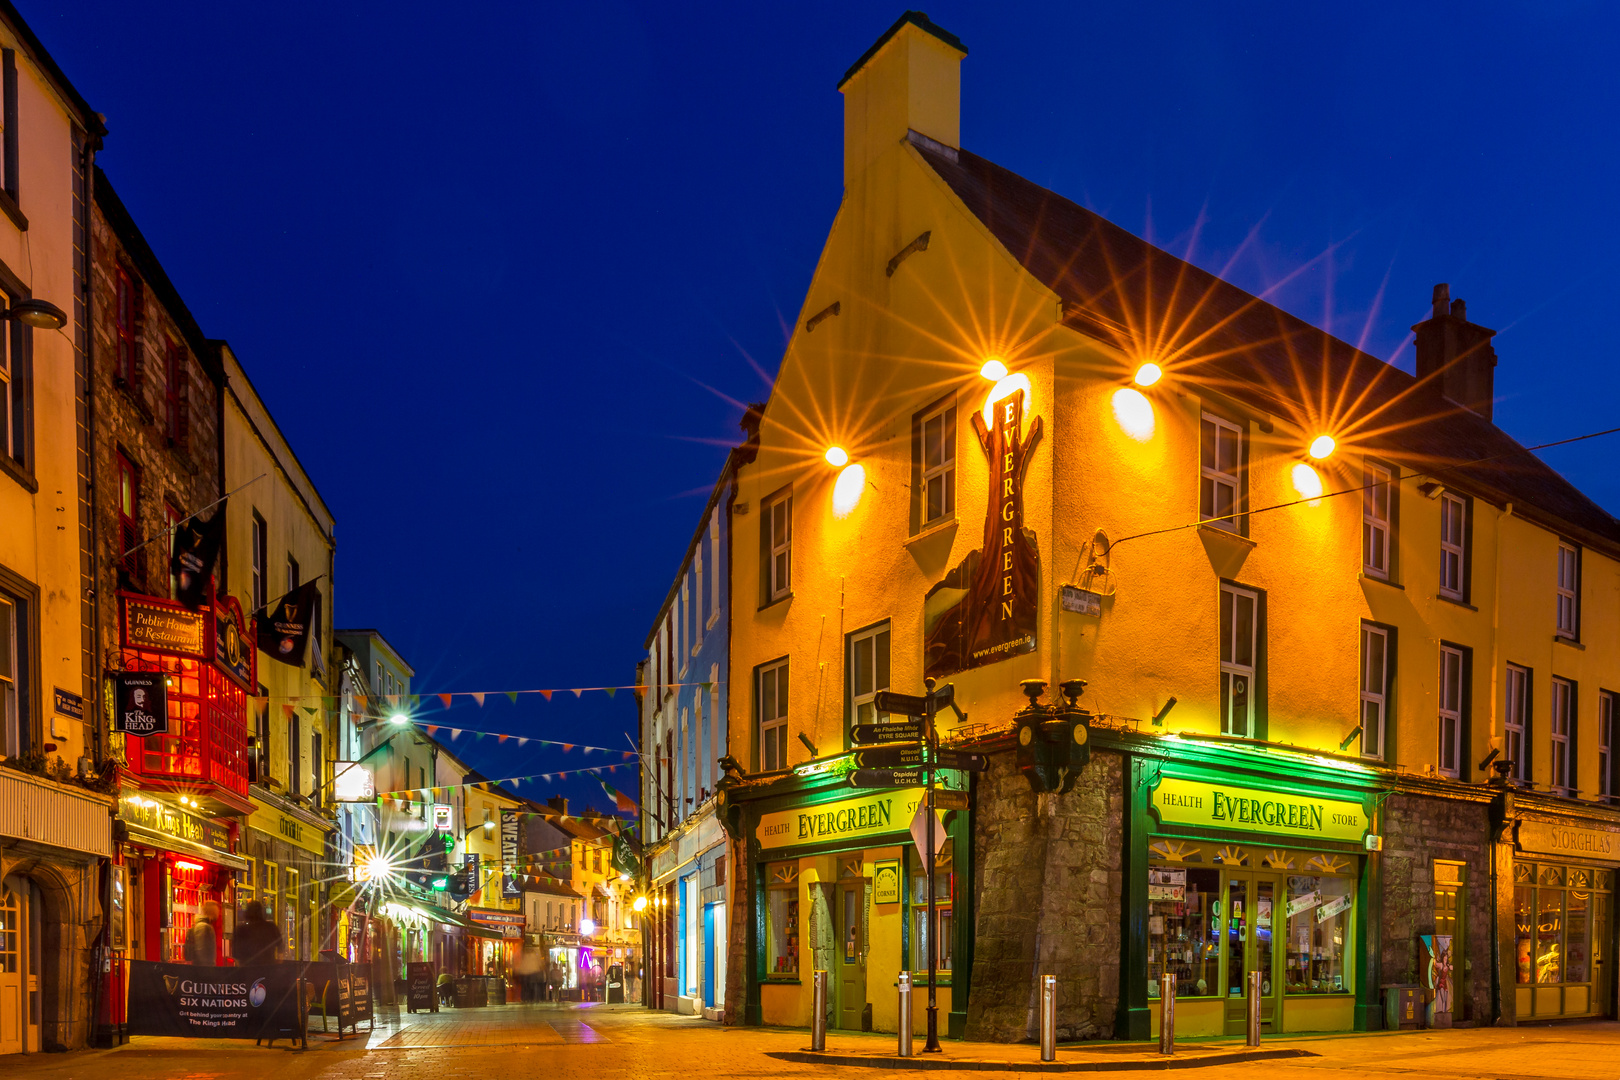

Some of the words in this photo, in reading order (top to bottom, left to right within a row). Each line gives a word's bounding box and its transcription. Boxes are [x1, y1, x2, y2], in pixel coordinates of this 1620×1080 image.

[1001, 402, 1015, 622] EVERGREEN
[136, 612, 165, 628] Public
[166, 617, 196, 632] House
[134, 627, 143, 638] &
[145, 626, 198, 645] Restaurant
[973, 633, 1032, 660] www.evergreen.ie
[133, 709, 144, 717] The
[125, 722, 154, 731] HEAD
[893, 771, 918, 779] Ospidéal
[155, 801, 180, 837] Kings
[764, 823, 790, 837] HEALTH
[797, 799, 892, 839] EVERGREEN
[1163, 793, 1203, 809] HEALTH
[1212, 791, 1323, 831] EVERGREEN
[1332, 813, 1358, 826] STORE
[1551, 826, 1612, 854] SÍORGHLAS
[876, 872, 897, 889] EVERGREEN
[877, 889, 897, 898] CORNER
[180, 980, 247, 995] GUINNESS
[180, 997, 199, 1007] SIX
[201, 998, 248, 1008] NATIONS
[189, 1018, 201, 1026] The
[202, 1019, 221, 1027] Kings
